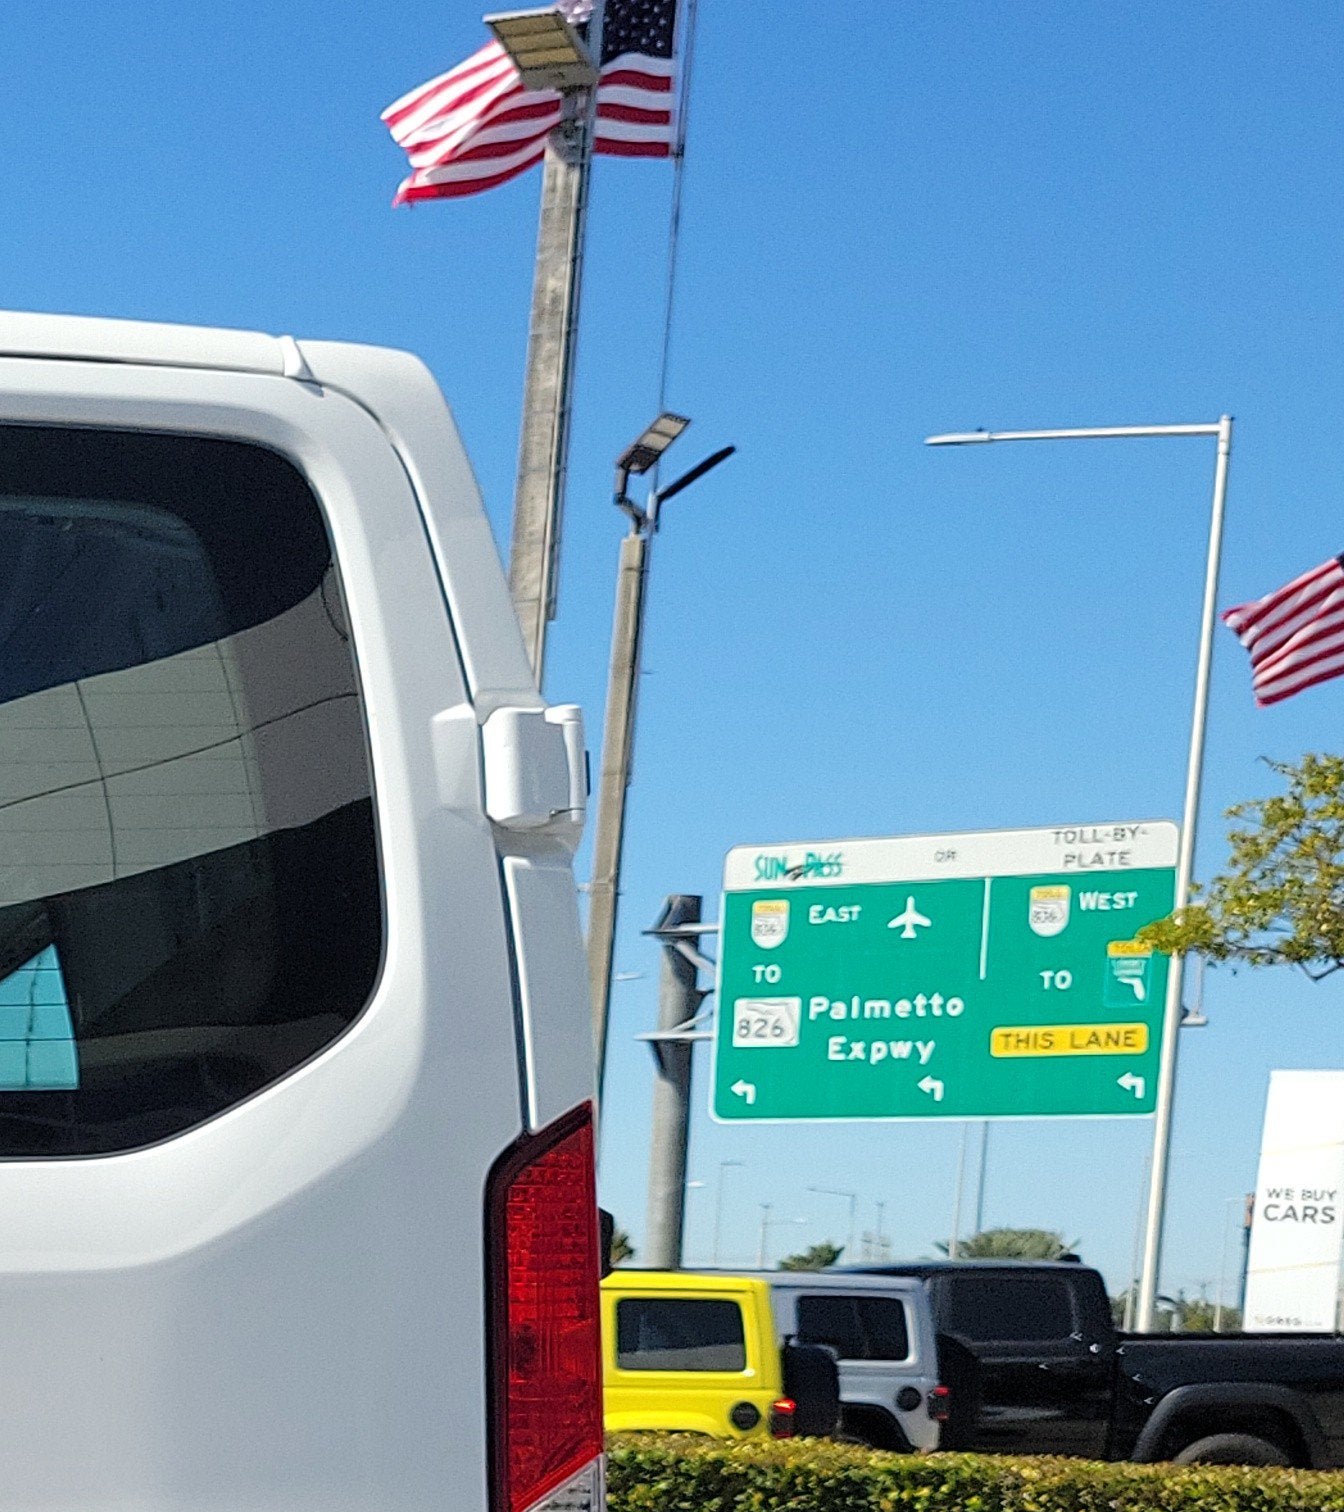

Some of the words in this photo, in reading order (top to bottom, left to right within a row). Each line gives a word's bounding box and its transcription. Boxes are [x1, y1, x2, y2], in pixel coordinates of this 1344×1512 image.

[934, 849, 956, 862] OR
[1063, 851, 1132, 868] PLATE
[1079, 891, 1138, 911] WEST
[809, 904, 862, 924] EAST
[752, 964, 782, 983] TO
[1039, 970, 1073, 990] TO
[809, 992, 964, 1020] Palmetto
[737, 1018, 785, 1038] 826
[999, 1032, 1054, 1050] THIS
[1070, 1029, 1137, 1049] LANE
[827, 1035, 935, 1065] Expwy
[1266, 1188, 1294, 1200] WE
[1301, 1189, 1337, 1201] BUY
[1264, 1204, 1334, 1223] CARS
